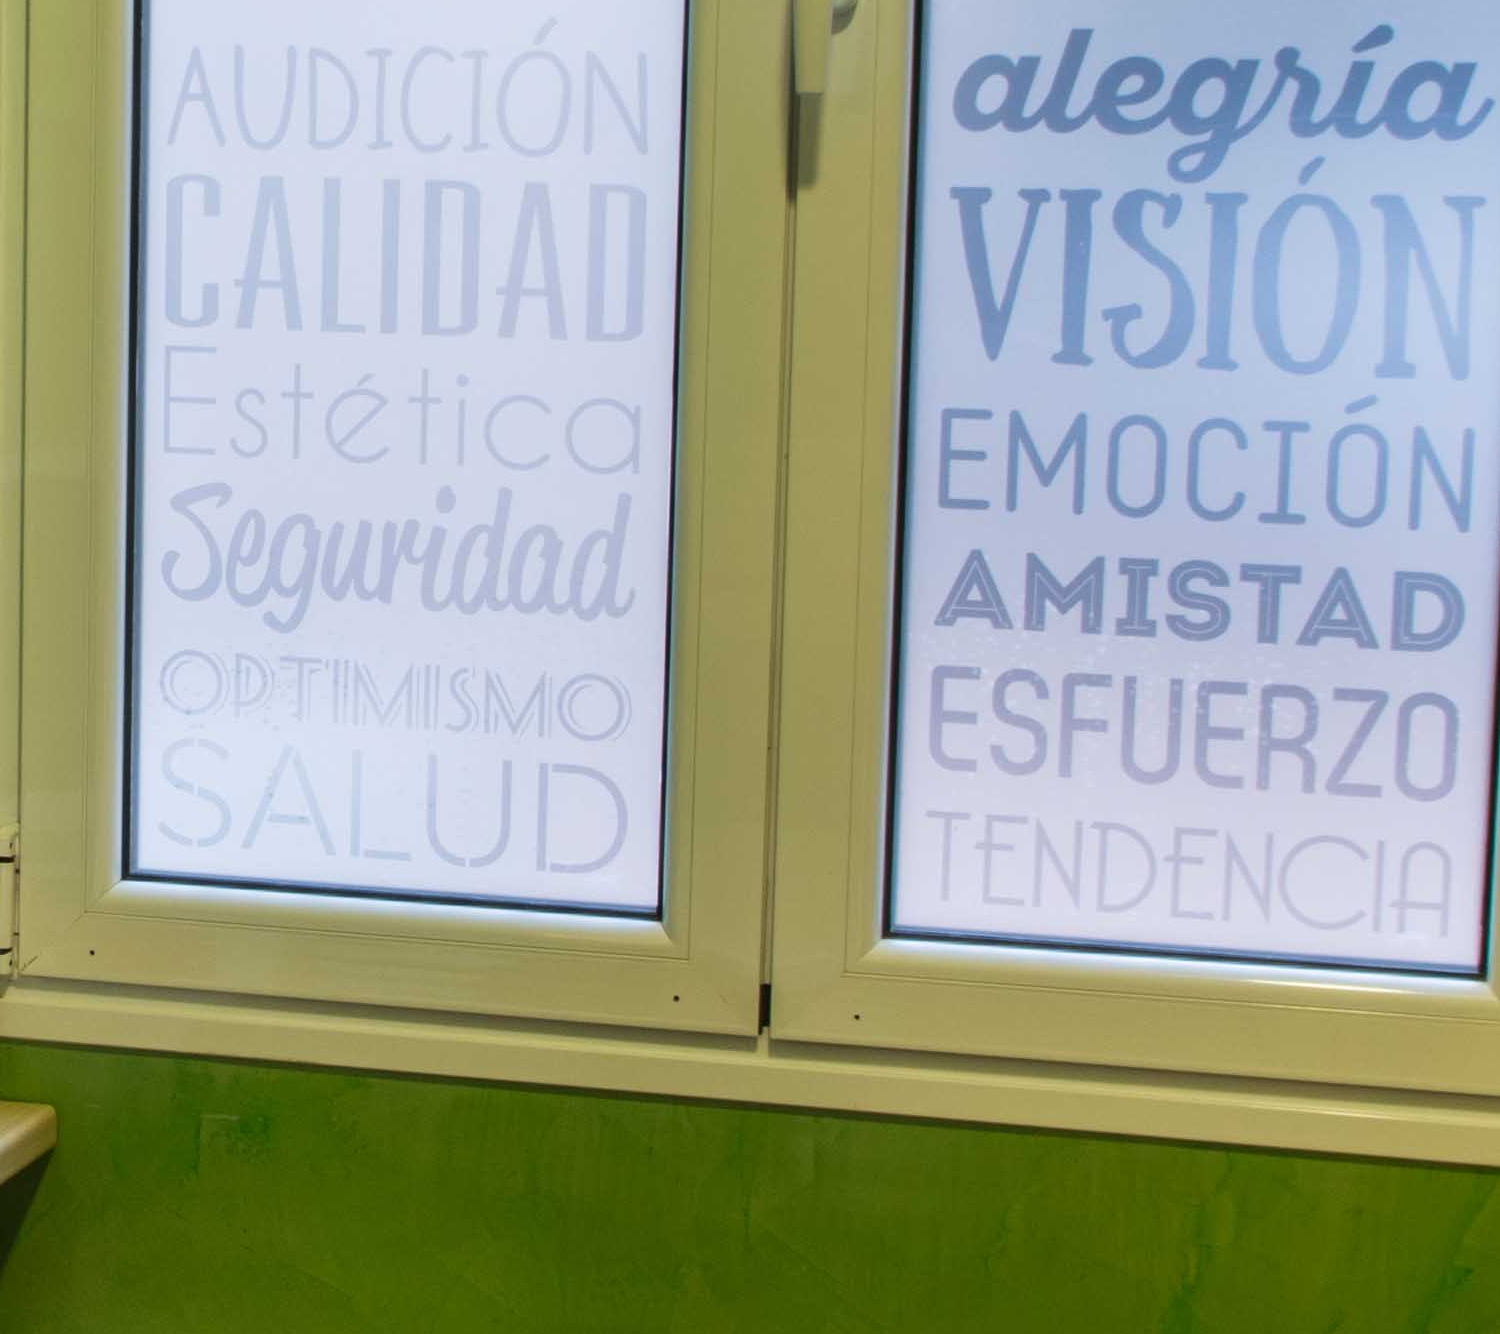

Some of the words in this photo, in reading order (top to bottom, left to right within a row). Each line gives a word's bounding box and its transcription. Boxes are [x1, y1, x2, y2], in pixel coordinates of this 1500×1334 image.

[166, 17, 649, 158] AUDICIÓN
[952, 24, 1495, 184] alegría
[164, 173, 649, 342] CALIDAD
[950, 156, 1488, 381] VISIÓN
[162, 345, 642, 475] Estética
[937, 394, 1475, 534] EMOCIÓN
[161, 482, 636, 634] Seguridad
[934, 548, 1467, 653] AMISTAD
[159, 648, 633, 743] OPTIMISMO
[928, 663, 1460, 802] ESFUERZO
[157, 736, 629, 874] SALUD
[925, 810, 1453, 938] TENDENCIA
